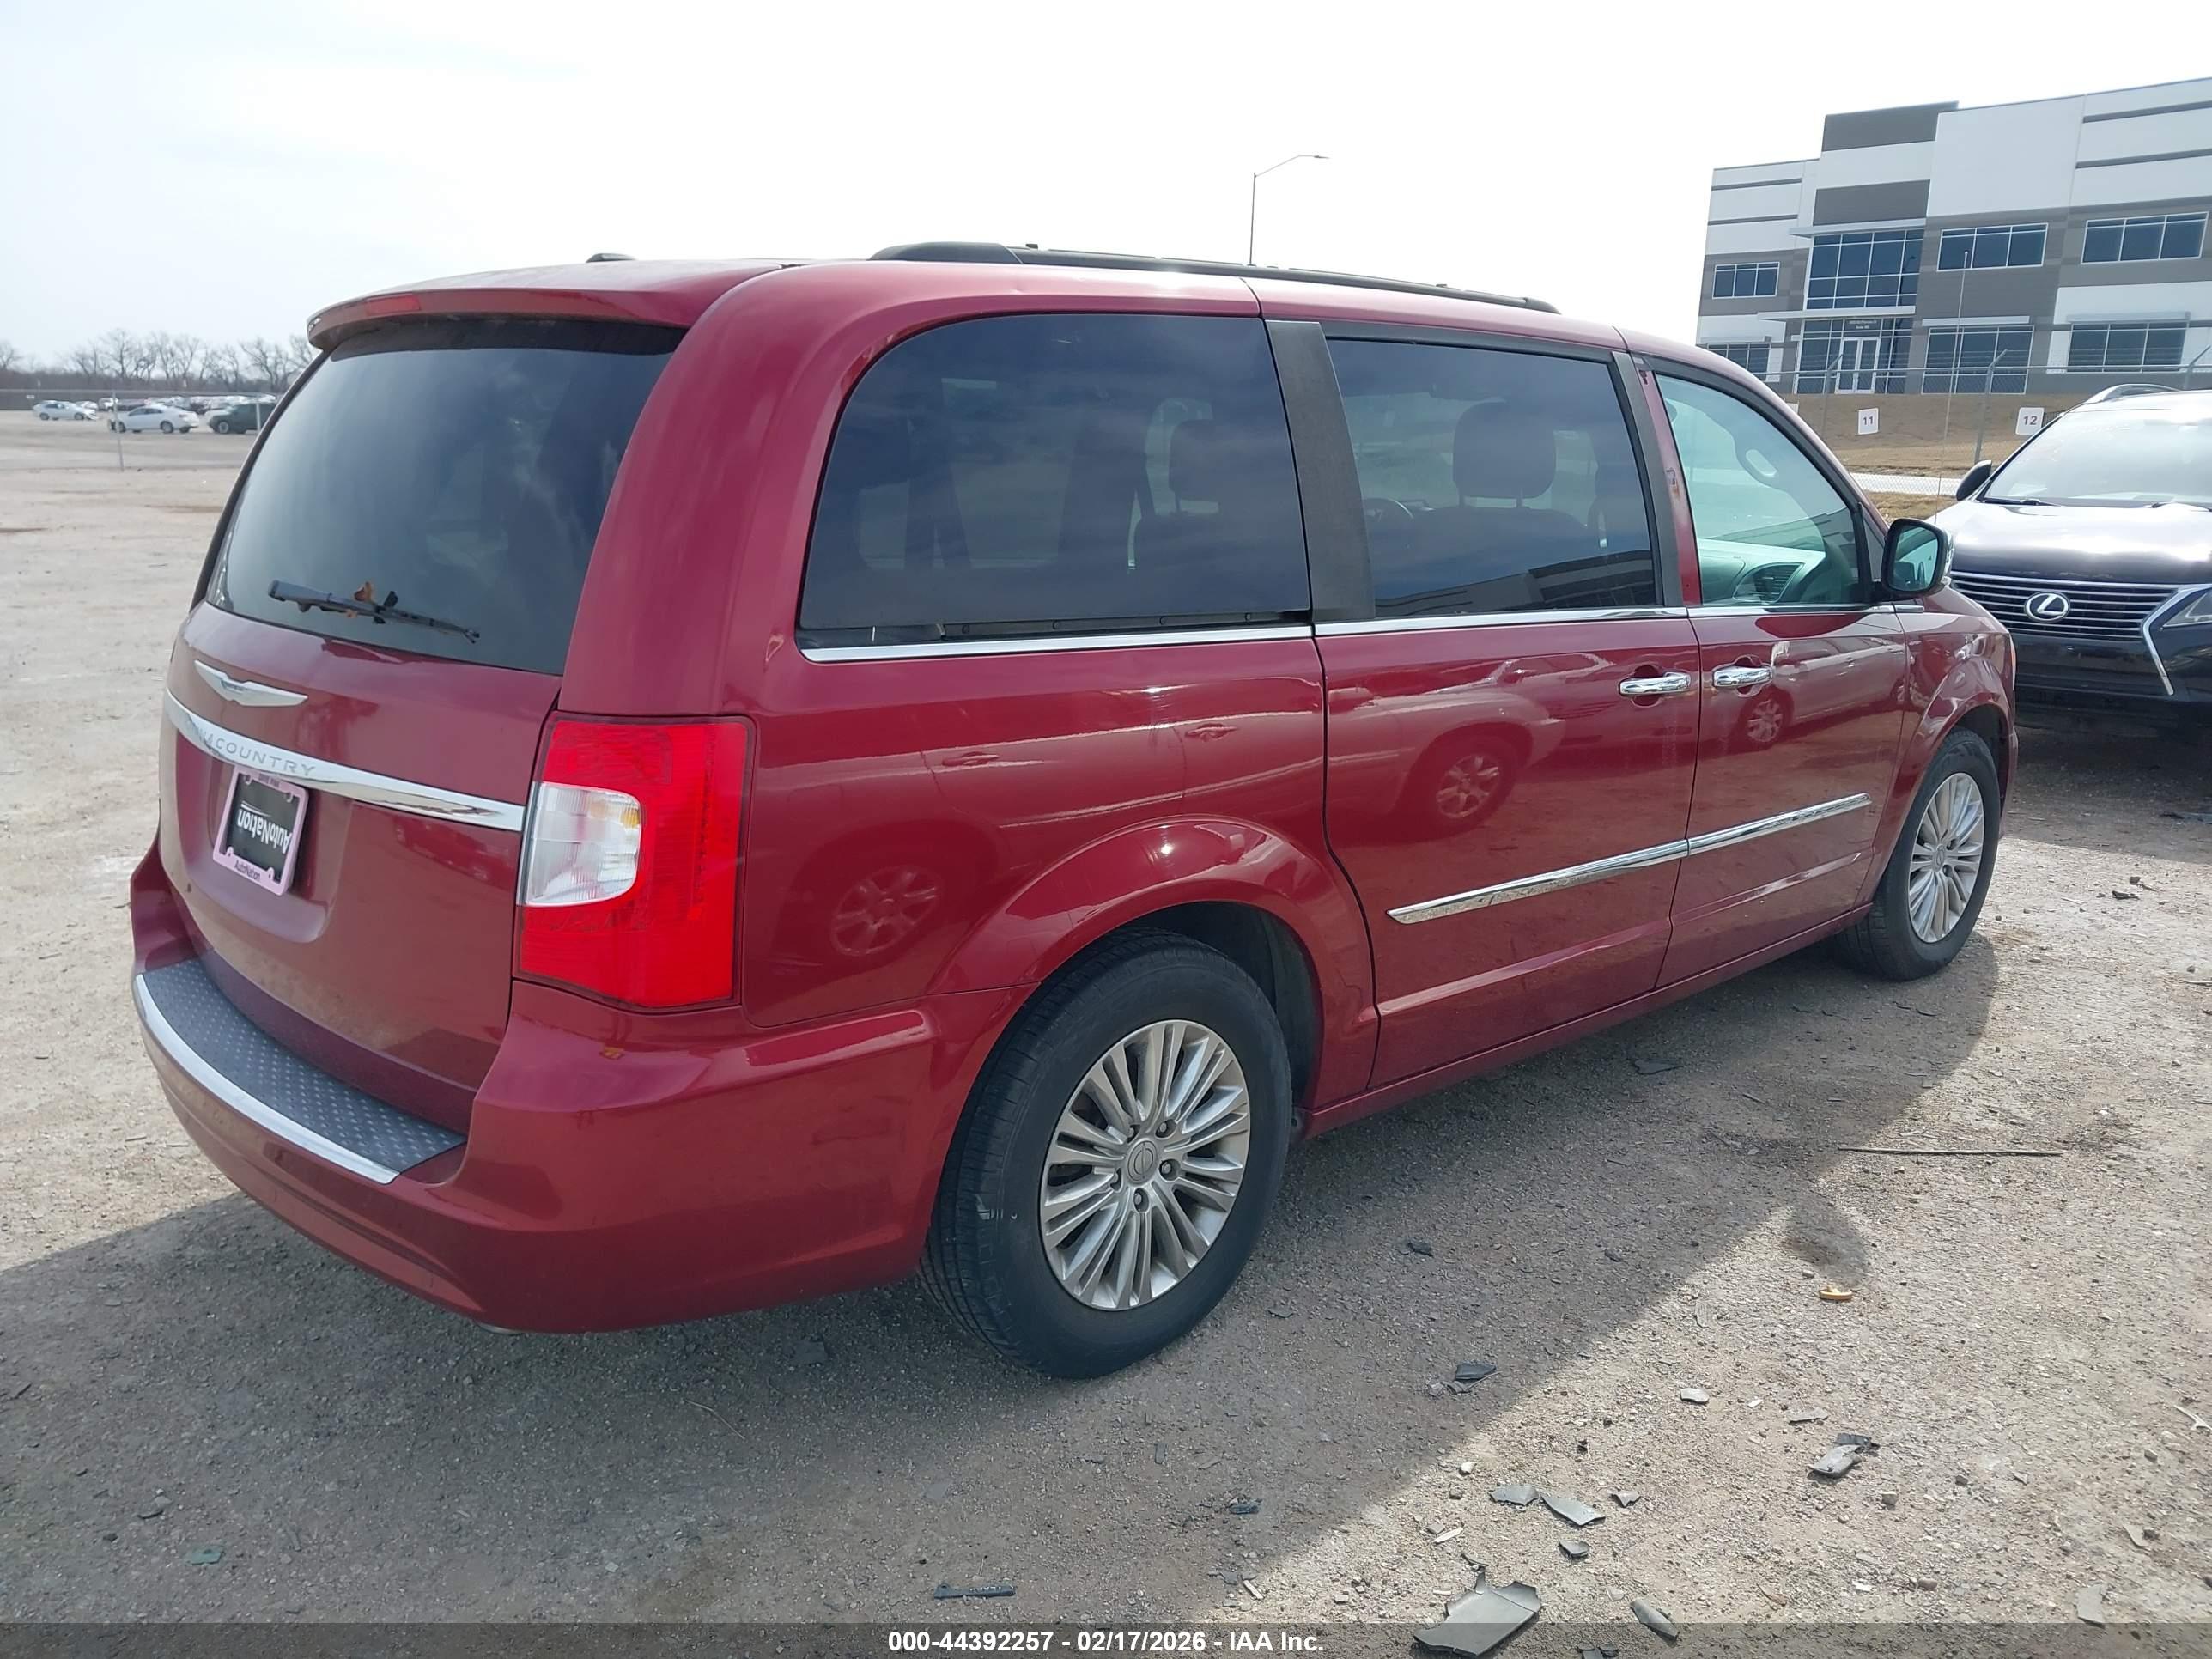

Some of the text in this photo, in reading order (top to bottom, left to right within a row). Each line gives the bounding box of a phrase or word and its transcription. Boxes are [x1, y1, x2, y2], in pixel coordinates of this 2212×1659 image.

[1863, 416, 1874, 426] 11
[2023, 416, 2038, 426] 12
[216, 738, 316, 776] COUNTRY
[237, 809, 293, 854] AutoNation
